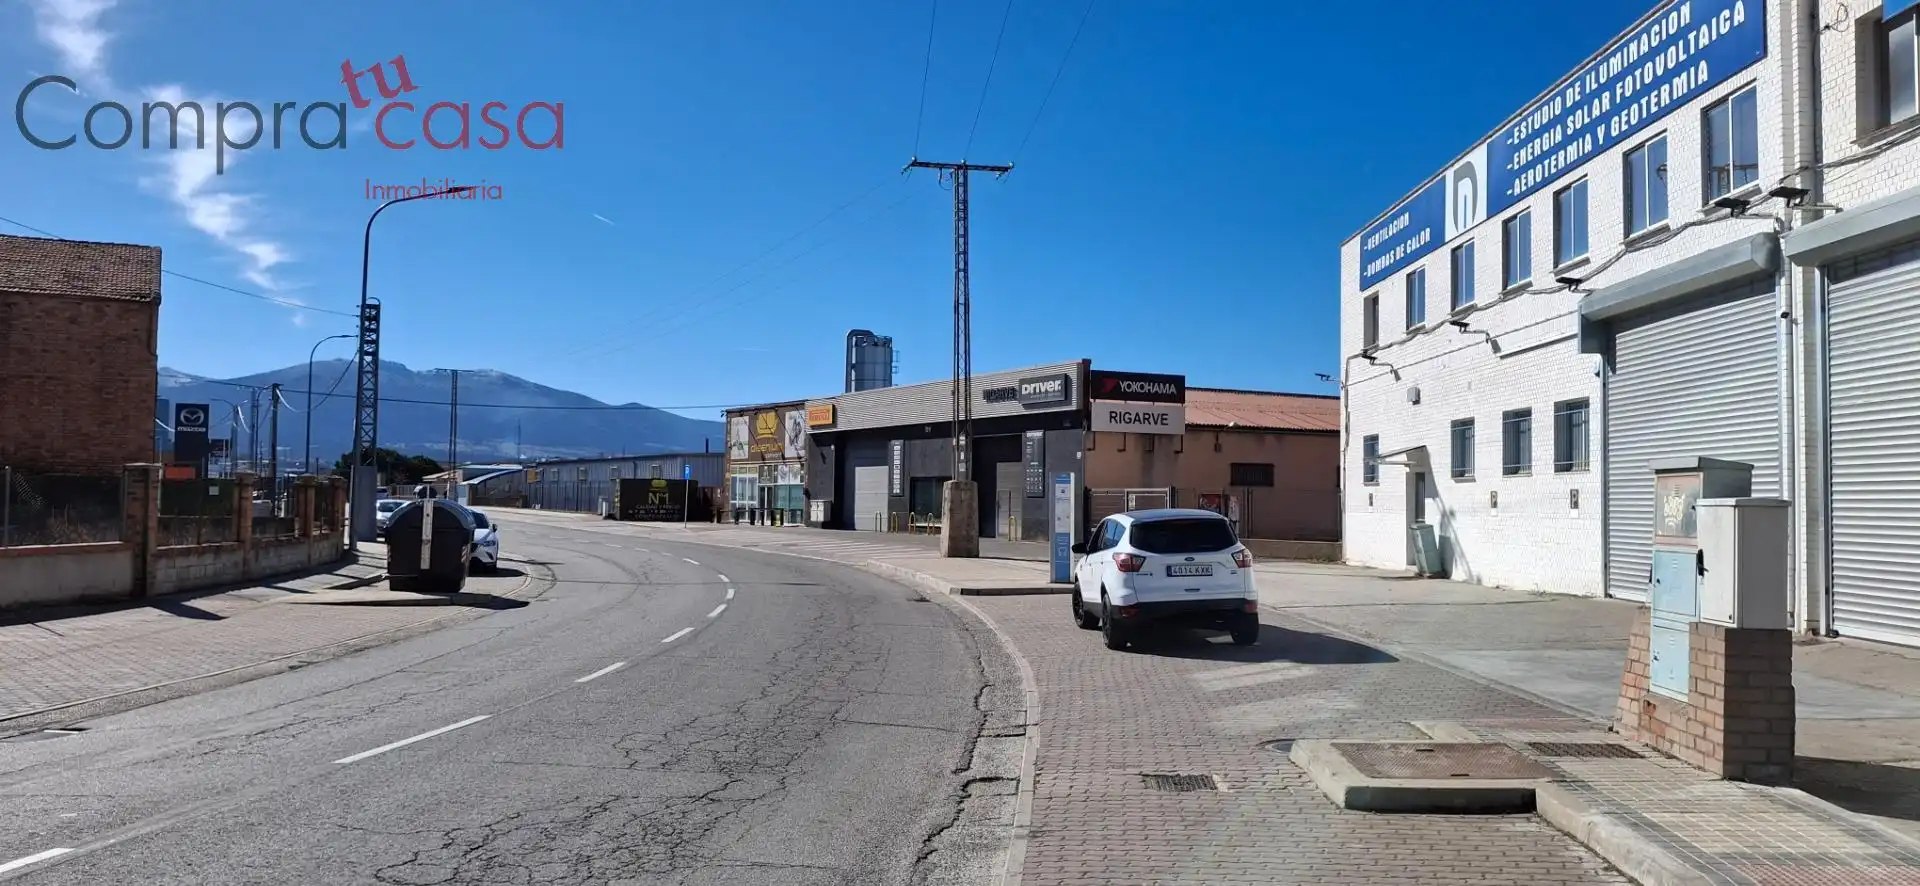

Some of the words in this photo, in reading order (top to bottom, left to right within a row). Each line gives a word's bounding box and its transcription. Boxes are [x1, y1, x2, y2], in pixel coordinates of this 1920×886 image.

[1566, 80, 1581, 108] DE
[1585, 0, 1691, 94] ILUMINACION
[1566, 91, 1611, 135] SOLAR
[1615, 0, 1745, 104] FOTOVOLTAICA
[1597, 123, 1606, 145] Y
[1610, 59, 1709, 137] GEOTERMIA
[1395, 243, 1405, 261] DE
[1406, 227, 1431, 254] CALOR
[1119, 380, 1177, 394] YOKOHAMA
[1109, 410, 1169, 426] RIGARVE
